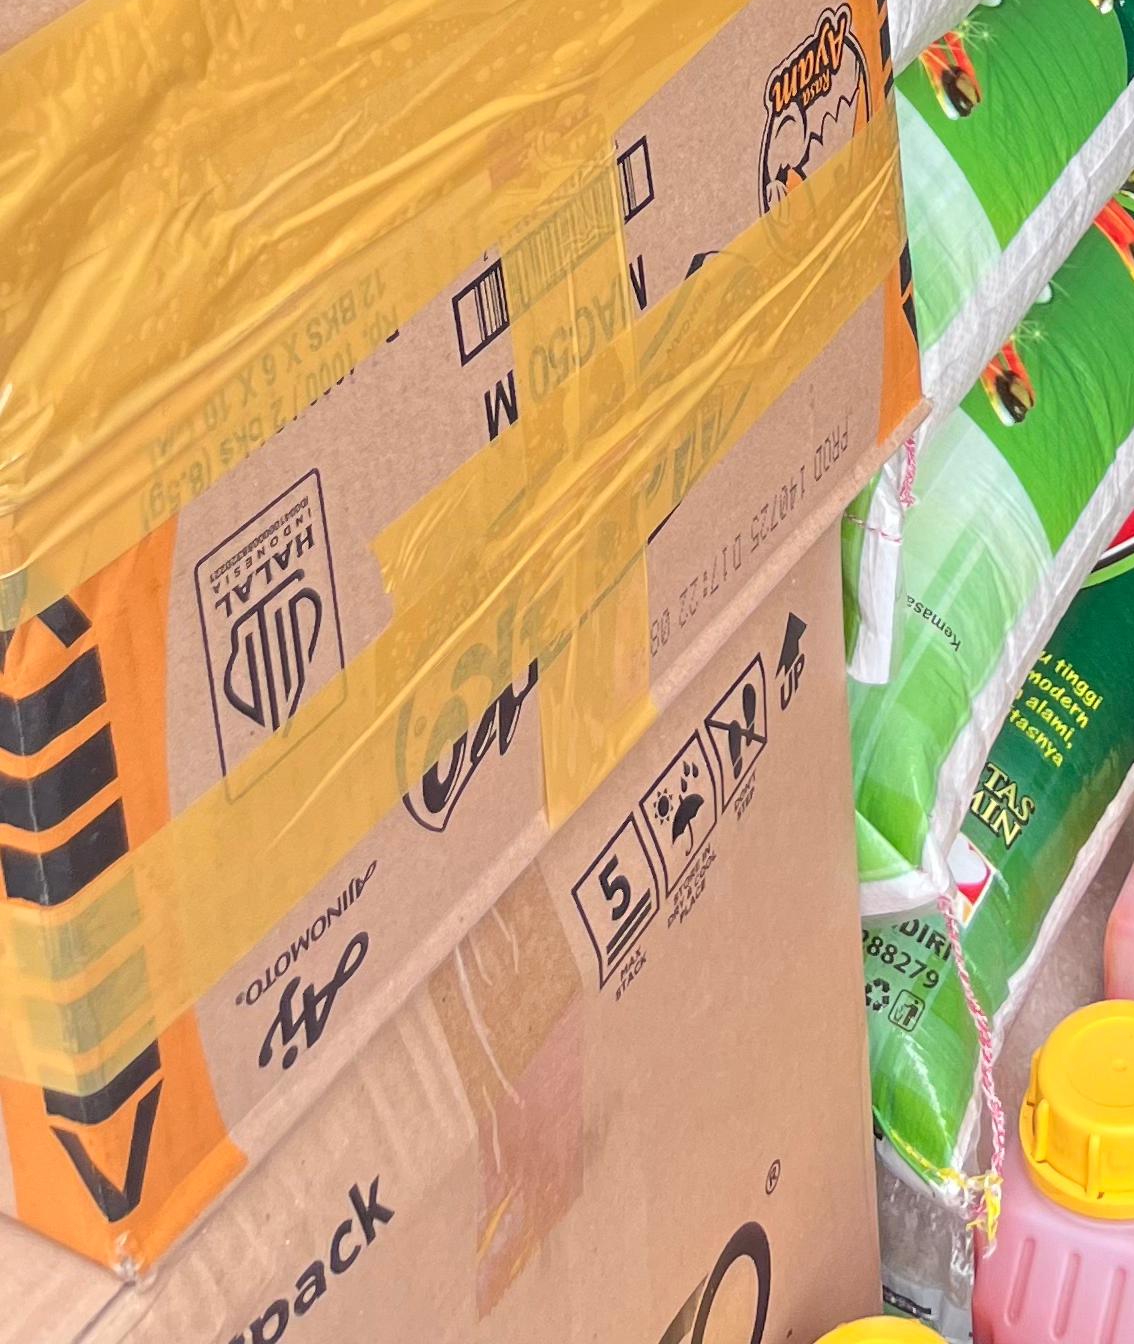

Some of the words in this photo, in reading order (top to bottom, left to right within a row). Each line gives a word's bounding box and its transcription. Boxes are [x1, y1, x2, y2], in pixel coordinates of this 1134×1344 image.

[772, 15, 847, 113] Ayam
[802, 67, 831, 106] Rasa
[813, 414, 852, 482] PROD
[212, 506, 312, 594] INDONESIA
[214, 522, 315, 618] HALAL
[905, 592, 961, 652] Kemasa
[780, 653, 806, 712] UP
[1026, 668, 1090, 729] modern
[1053, 657, 1104, 711] tinggi
[1009, 704, 1065, 768] tasnya
[984, 762, 1036, 823] TAS
[598, 853, 632, 921] 5
[899, 917, 952, 961] DIRI
[230, 1174, 396, 1344] pack
